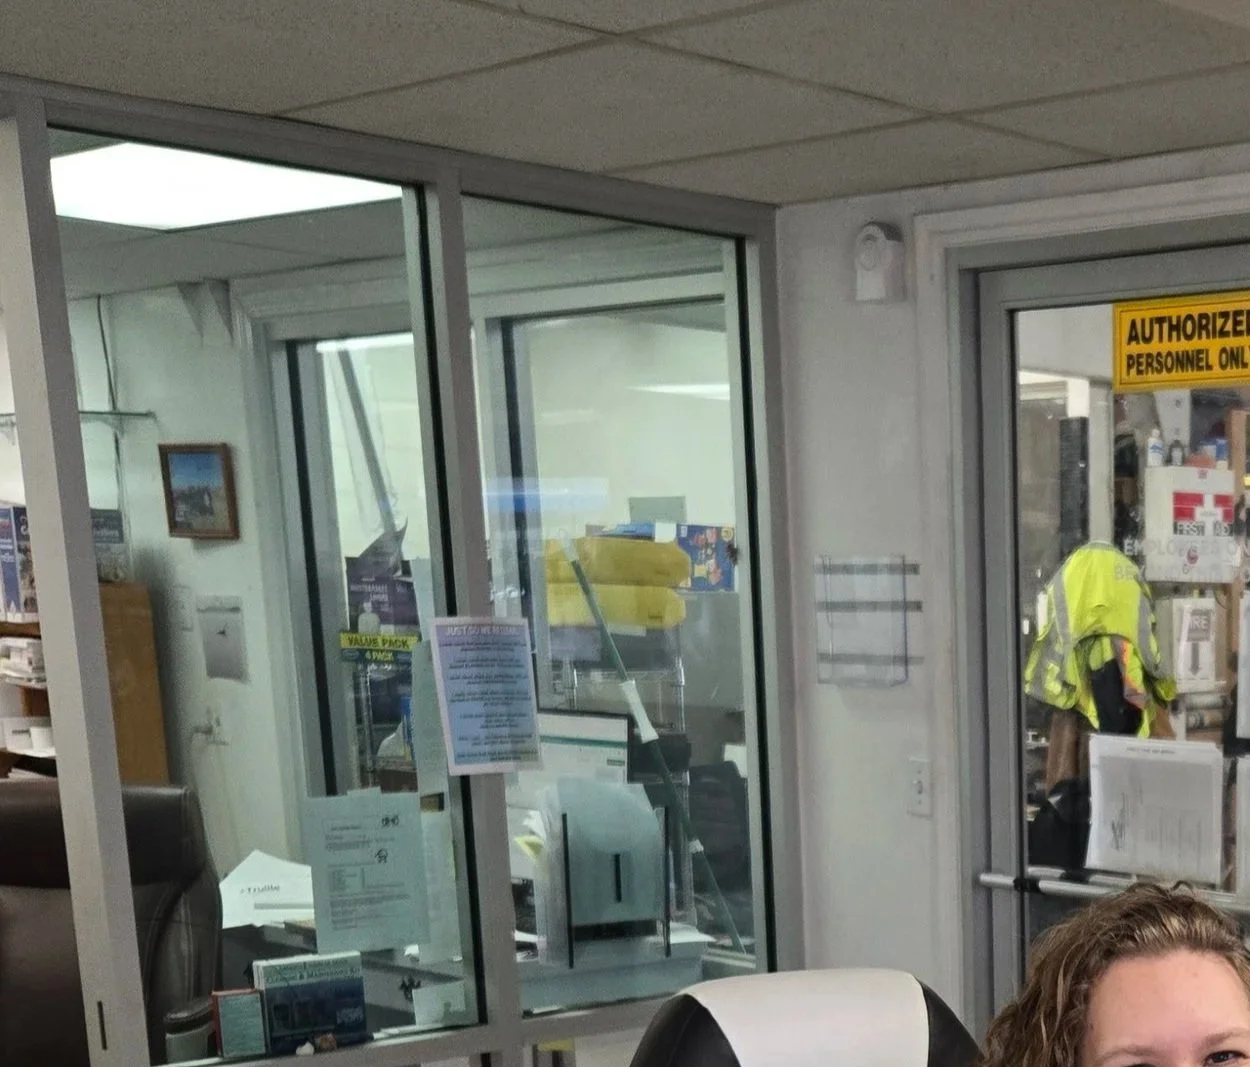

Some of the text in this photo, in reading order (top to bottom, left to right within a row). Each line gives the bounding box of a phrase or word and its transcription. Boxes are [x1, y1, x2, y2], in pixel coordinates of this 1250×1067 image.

[1127, 349, 1213, 376] PERSONNEL
[1174, 522, 1205, 535] FIRST
[348, 636, 410, 650] VALUE PACK
